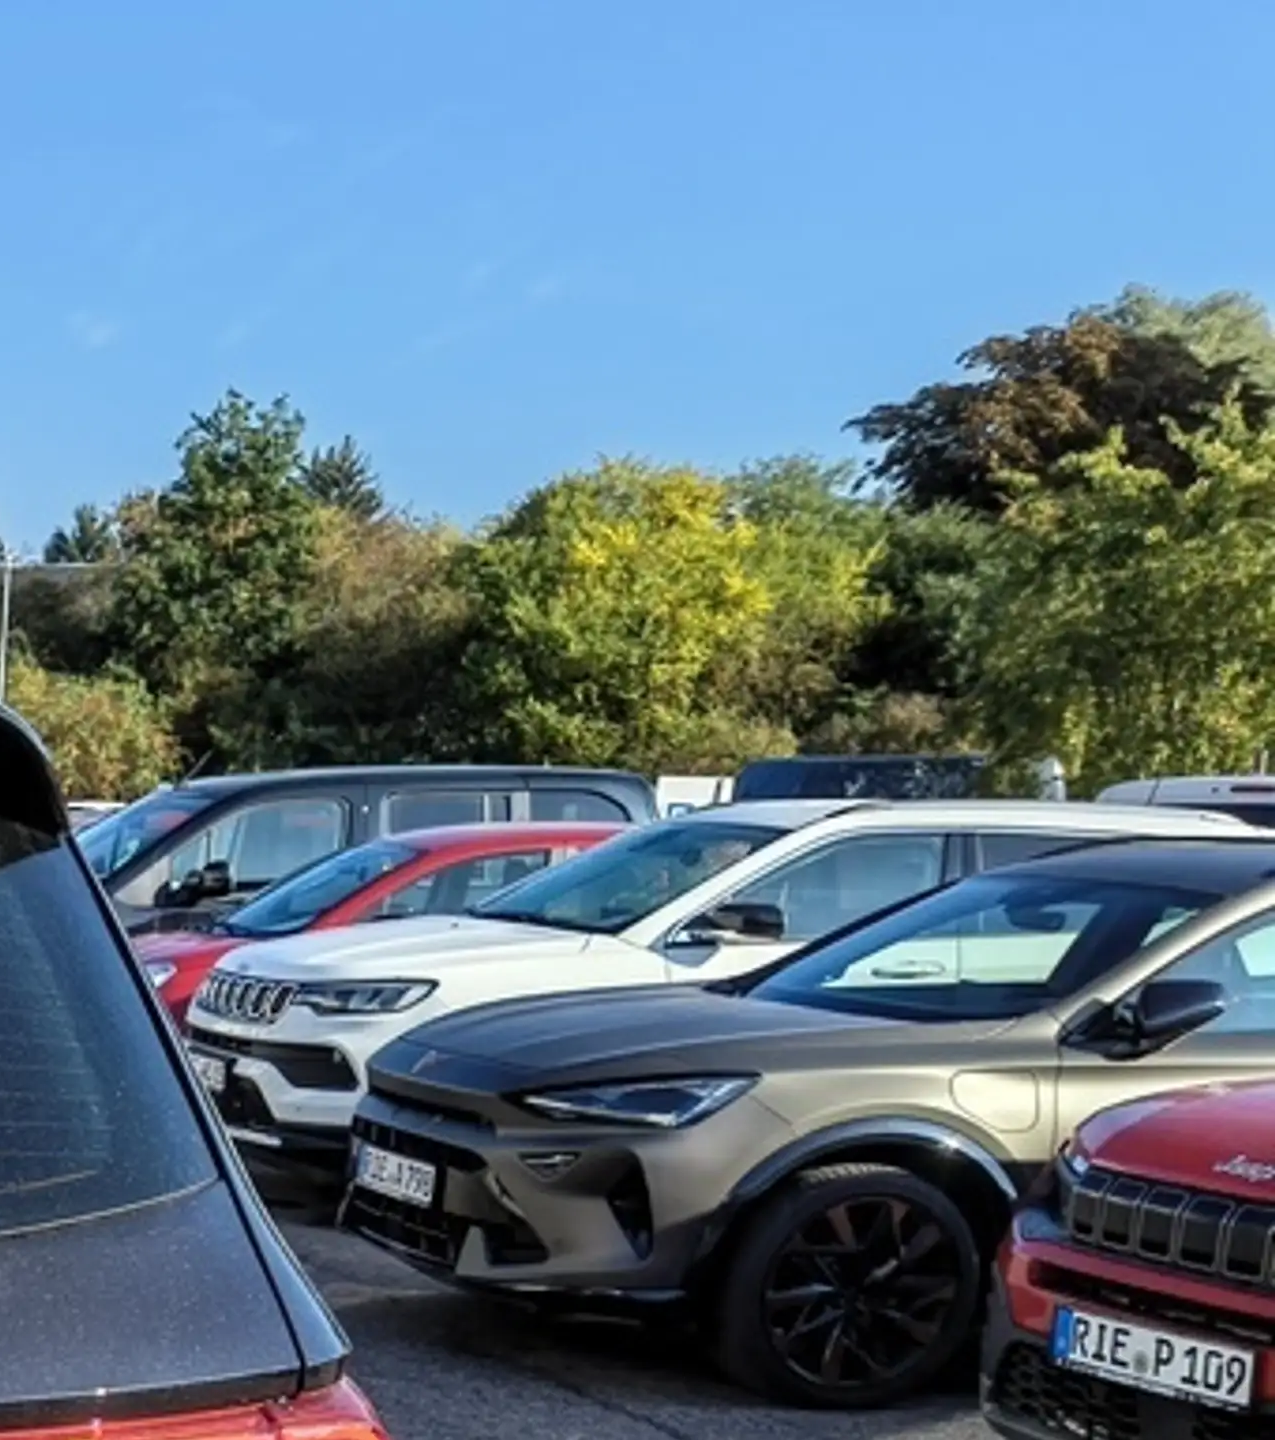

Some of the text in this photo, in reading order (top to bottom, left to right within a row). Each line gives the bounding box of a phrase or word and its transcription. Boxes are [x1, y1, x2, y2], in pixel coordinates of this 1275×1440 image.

[1072, 1314, 1247, 1397] RIE P 109
